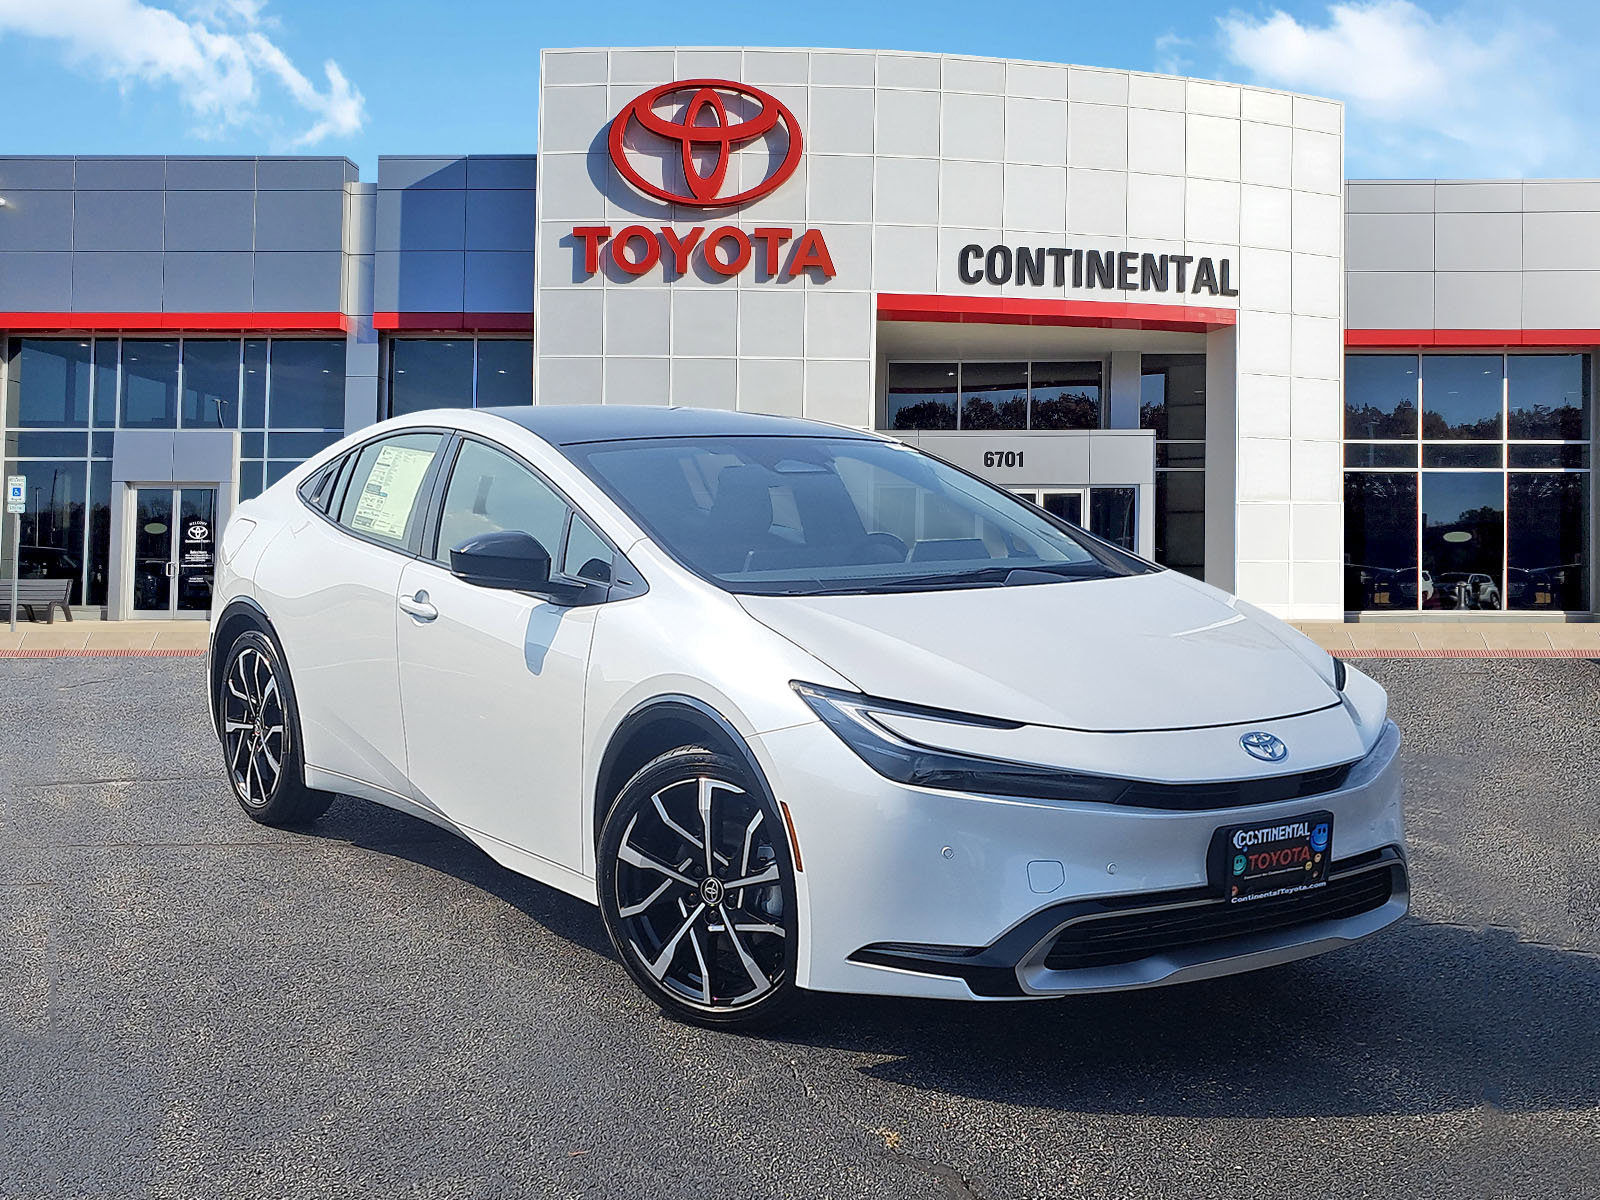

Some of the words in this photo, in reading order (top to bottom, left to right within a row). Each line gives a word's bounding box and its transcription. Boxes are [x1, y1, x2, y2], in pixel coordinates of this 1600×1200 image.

[572, 225, 837, 276] TOYOTA
[958, 244, 1239, 297] CONTINENTAL
[983, 451, 1024, 468] 6701
[1238, 822, 1311, 846] CONTINENTAL
[1248, 845, 1311, 871] TOYOTA
[1231, 881, 1327, 904] ContinentalToyota.com
